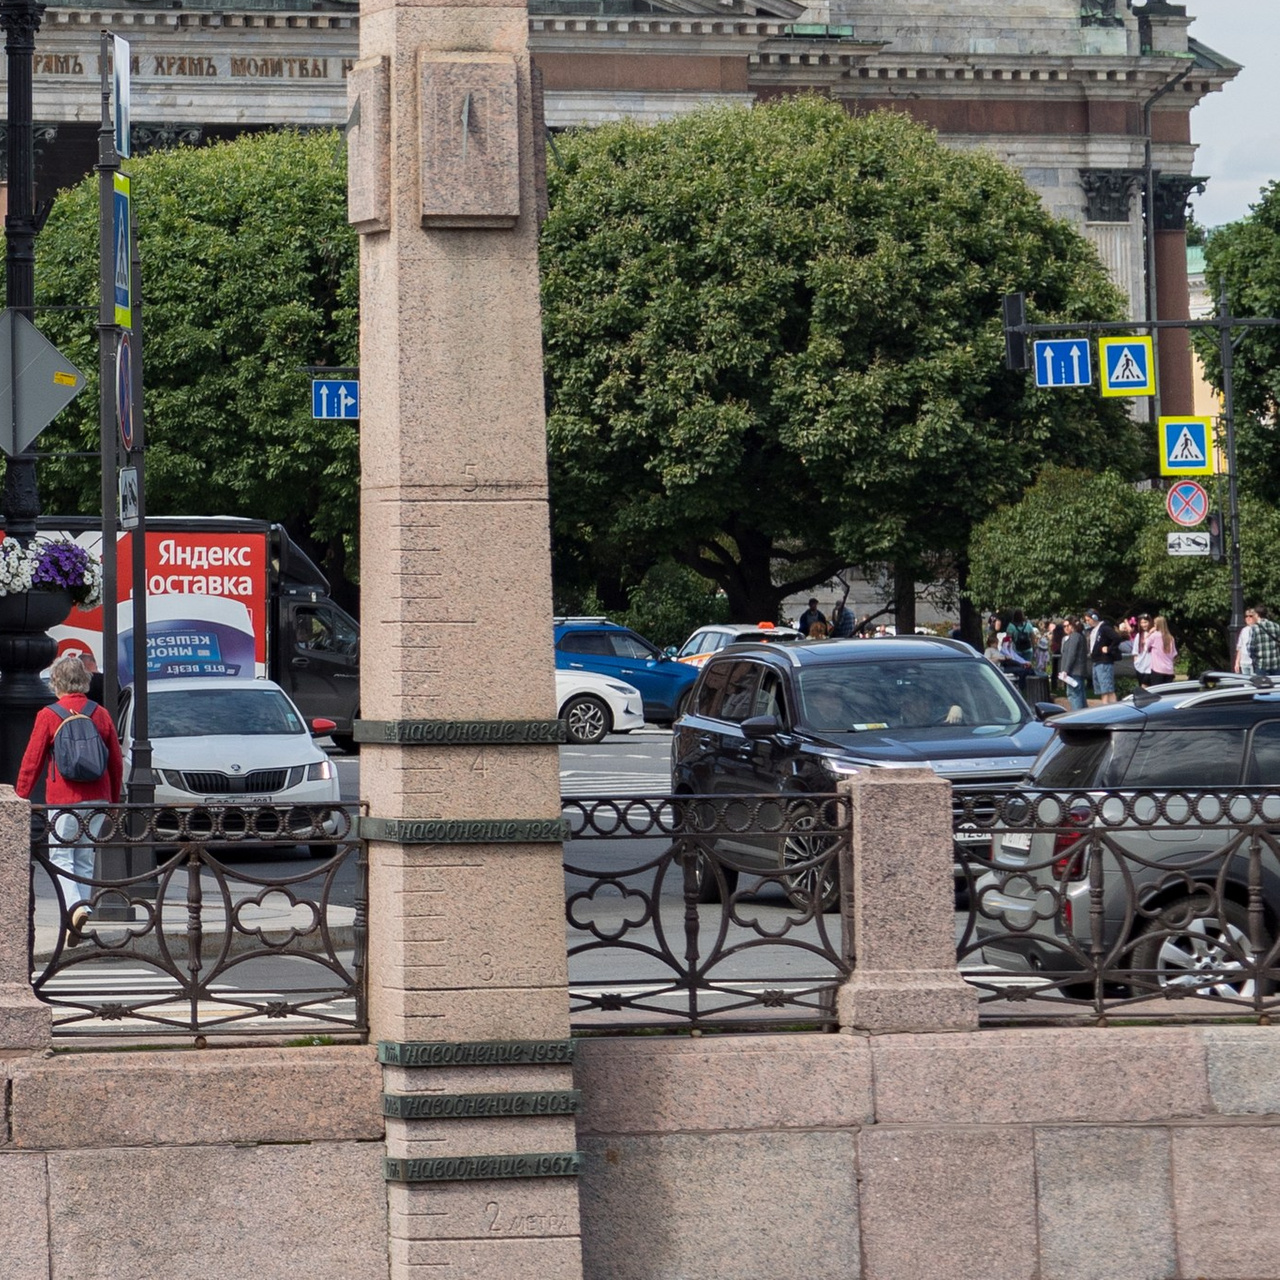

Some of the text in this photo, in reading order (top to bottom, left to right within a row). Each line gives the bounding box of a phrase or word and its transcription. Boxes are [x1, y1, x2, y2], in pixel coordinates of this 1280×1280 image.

[33, 54, 83, 75] РАМЪ
[154, 55, 217, 77] ХРАМЪ
[230, 56, 328, 79] МОЛИТВЫ
[460, 463, 478, 493] 5
[158, 539, 251, 570] Яндекс
[147, 647, 193, 658] МНОГ
[204, 664, 226, 673] ВТБ
[470, 748, 490, 780] 4
[400, 821, 517, 840] наводнение
[479, 951, 495, 982] 3
[404, 1043, 522, 1063] наводнение
[406, 1095, 524, 1116] наводнение
[407, 1157, 527, 1179] наводнение
[484, 1200, 502, 1232] 2
